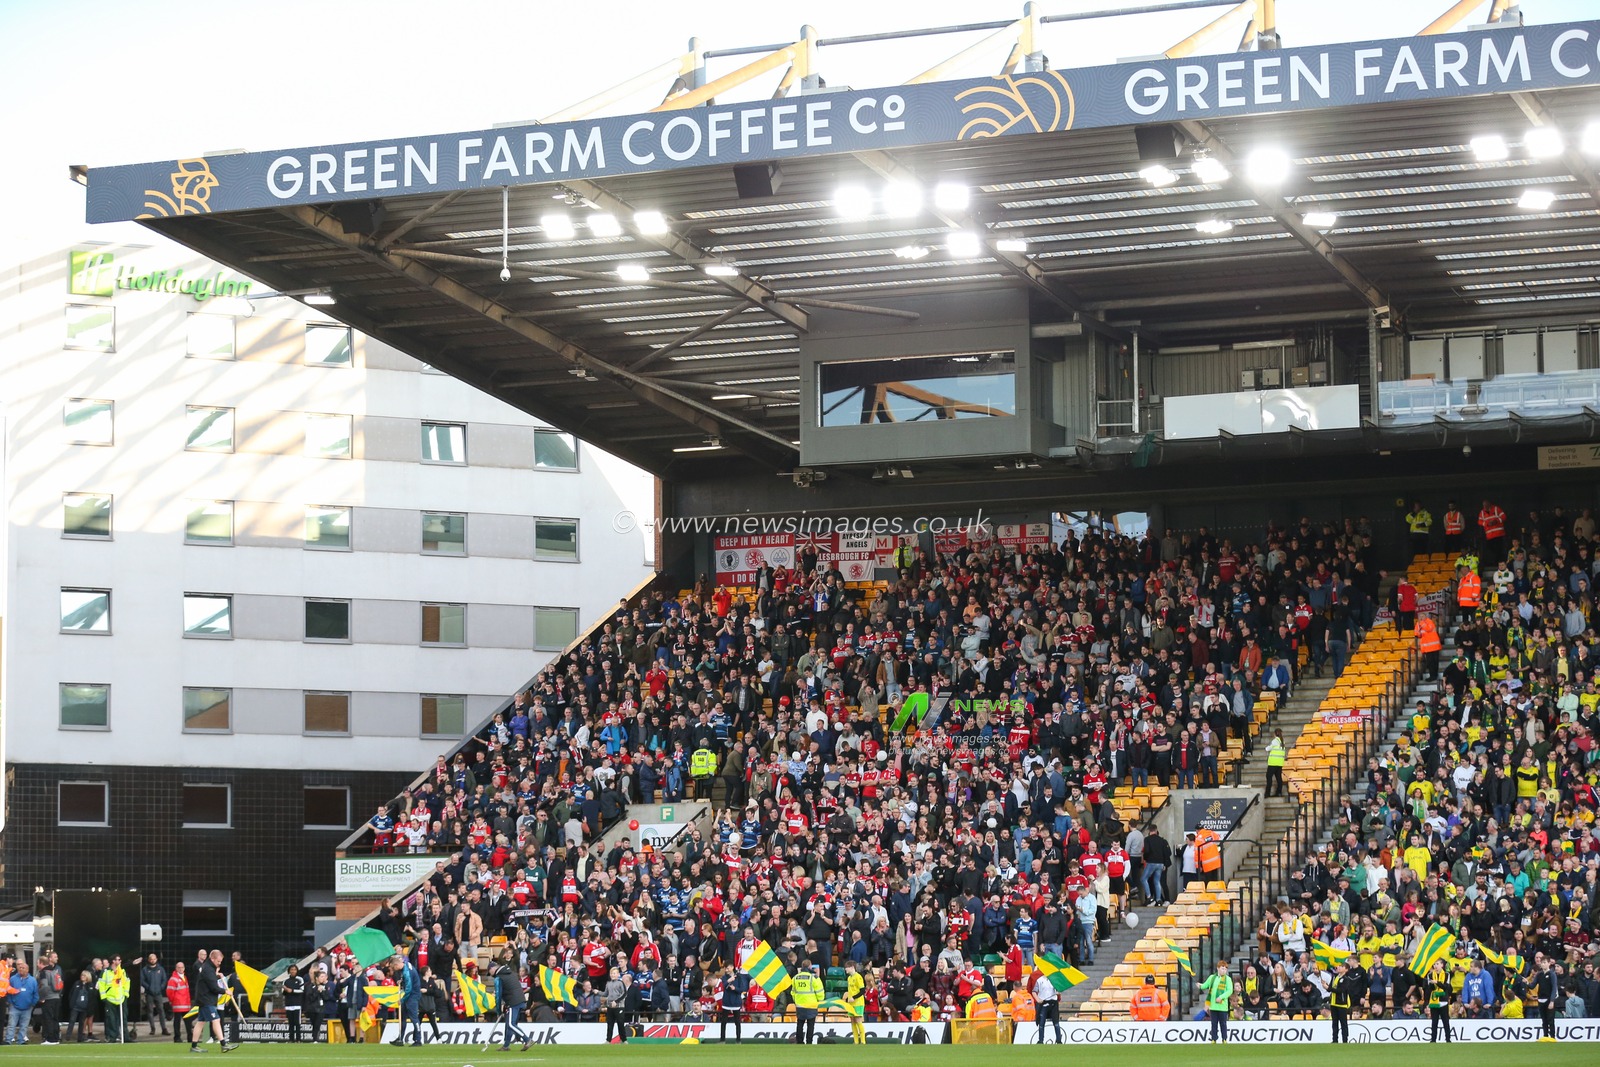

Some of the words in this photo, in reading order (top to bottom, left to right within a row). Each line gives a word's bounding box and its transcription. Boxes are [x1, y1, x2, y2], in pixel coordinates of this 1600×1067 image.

[1123, 52, 1330, 116] GREEN
[1354, 34, 1532, 96] FARM
[1550, 28, 1600, 79] C
[266, 141, 439, 199] GREEN
[457, 126, 607, 182] FARM
[621, 101, 833, 165] COFFEE
[720, 536, 738, 548] DEEP
[740, 535, 749, 546] IN
[750, 535, 764, 546] MY
[765, 534, 790, 544] HEART
[860, 552, 870, 560] FC
[737, 573, 747, 583] DO
[662, 808, 672, 820] F
[1070, 1028, 1163, 1042] COASTAL
